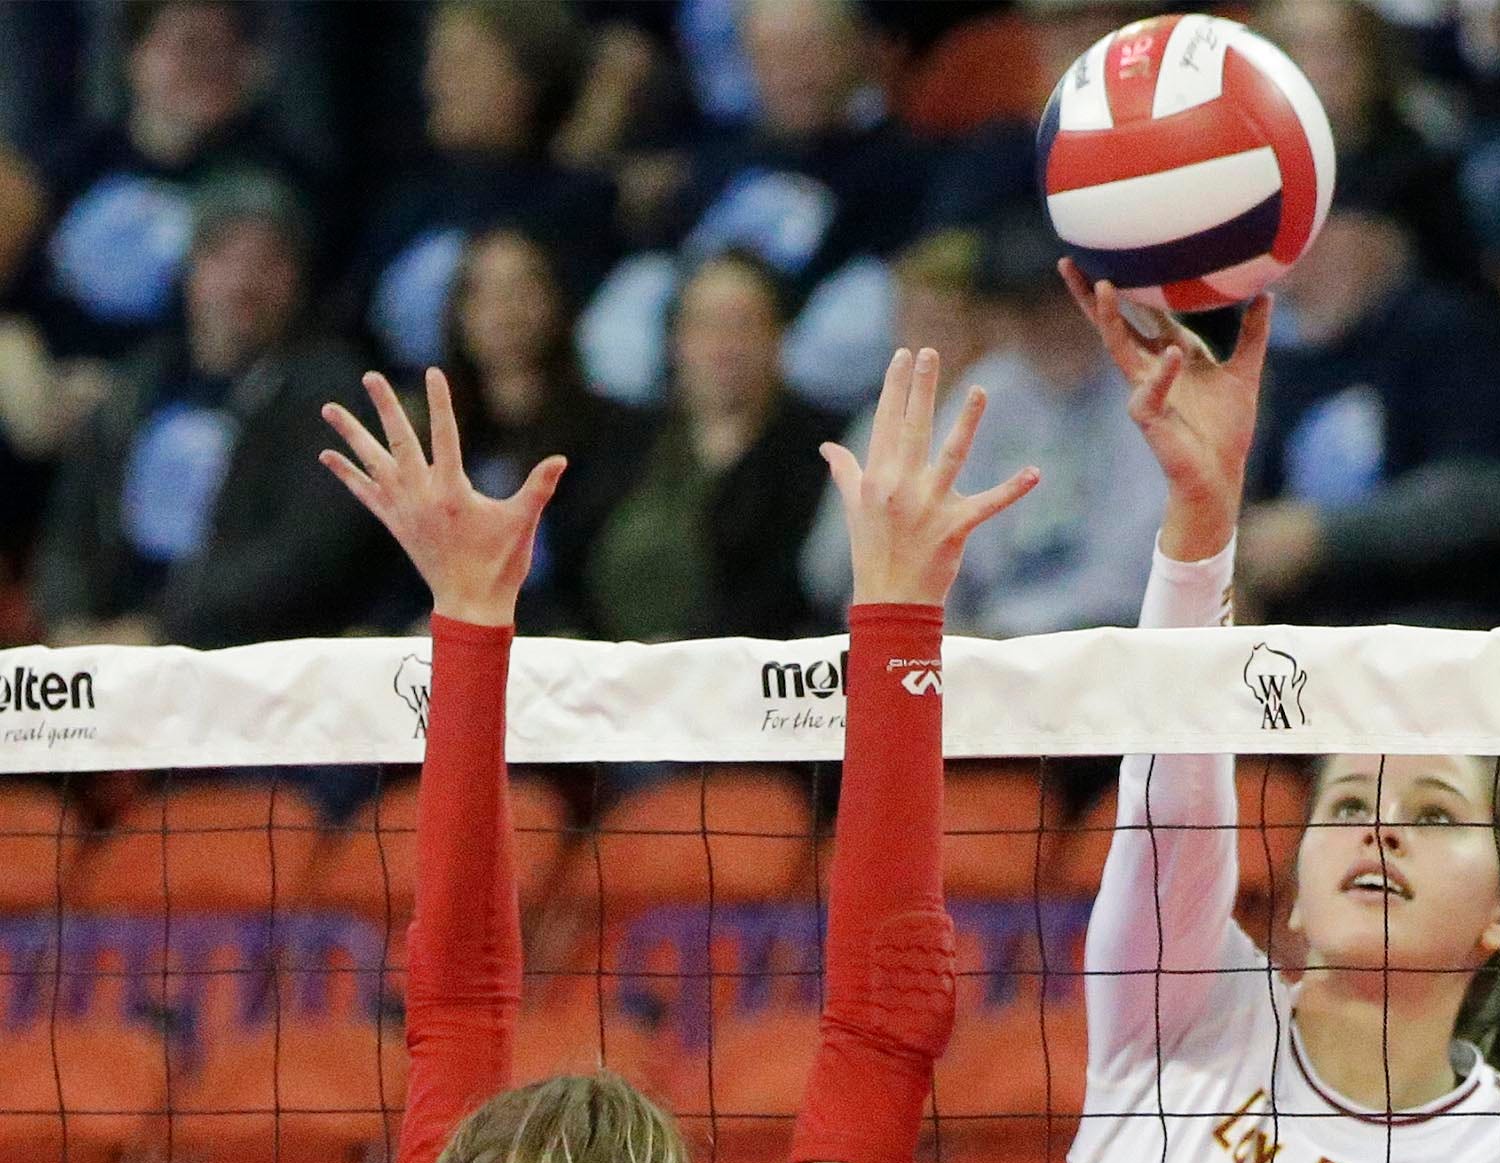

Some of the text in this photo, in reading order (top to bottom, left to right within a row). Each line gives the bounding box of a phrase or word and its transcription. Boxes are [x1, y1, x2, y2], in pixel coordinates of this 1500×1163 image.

[762, 651, 849, 699] mol
[762, 708, 788, 731] For
[793, 708, 825, 729] the
